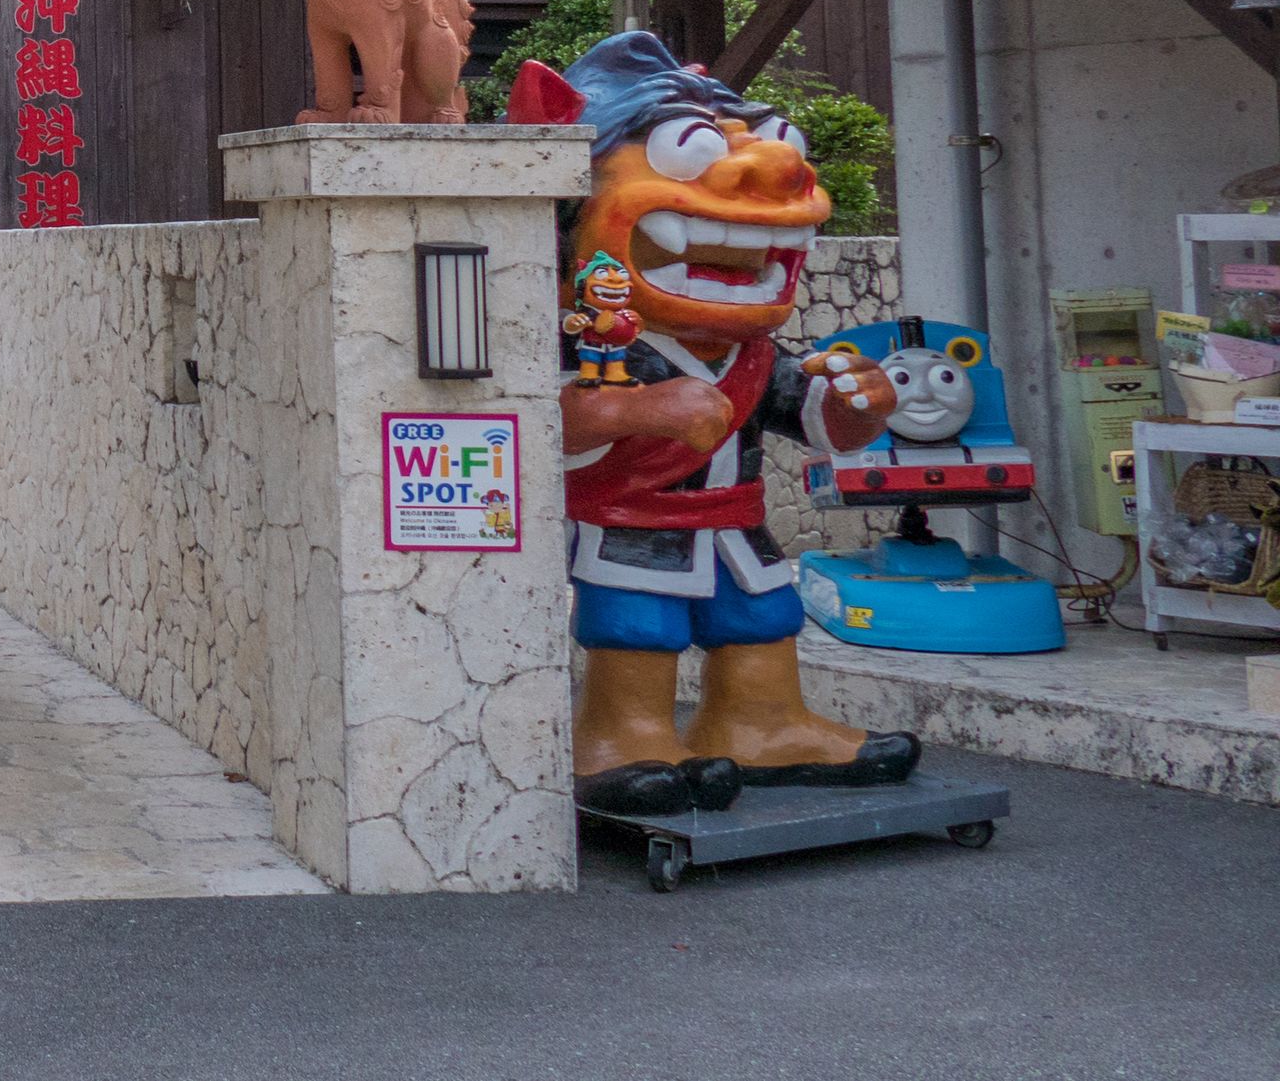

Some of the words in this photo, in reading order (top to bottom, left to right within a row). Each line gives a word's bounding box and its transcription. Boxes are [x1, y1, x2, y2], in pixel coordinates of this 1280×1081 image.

[396, 425, 441, 438] FREE
[393, 444, 503, 478] Wi-Fi
[401, 482, 473, 504] SPOT
